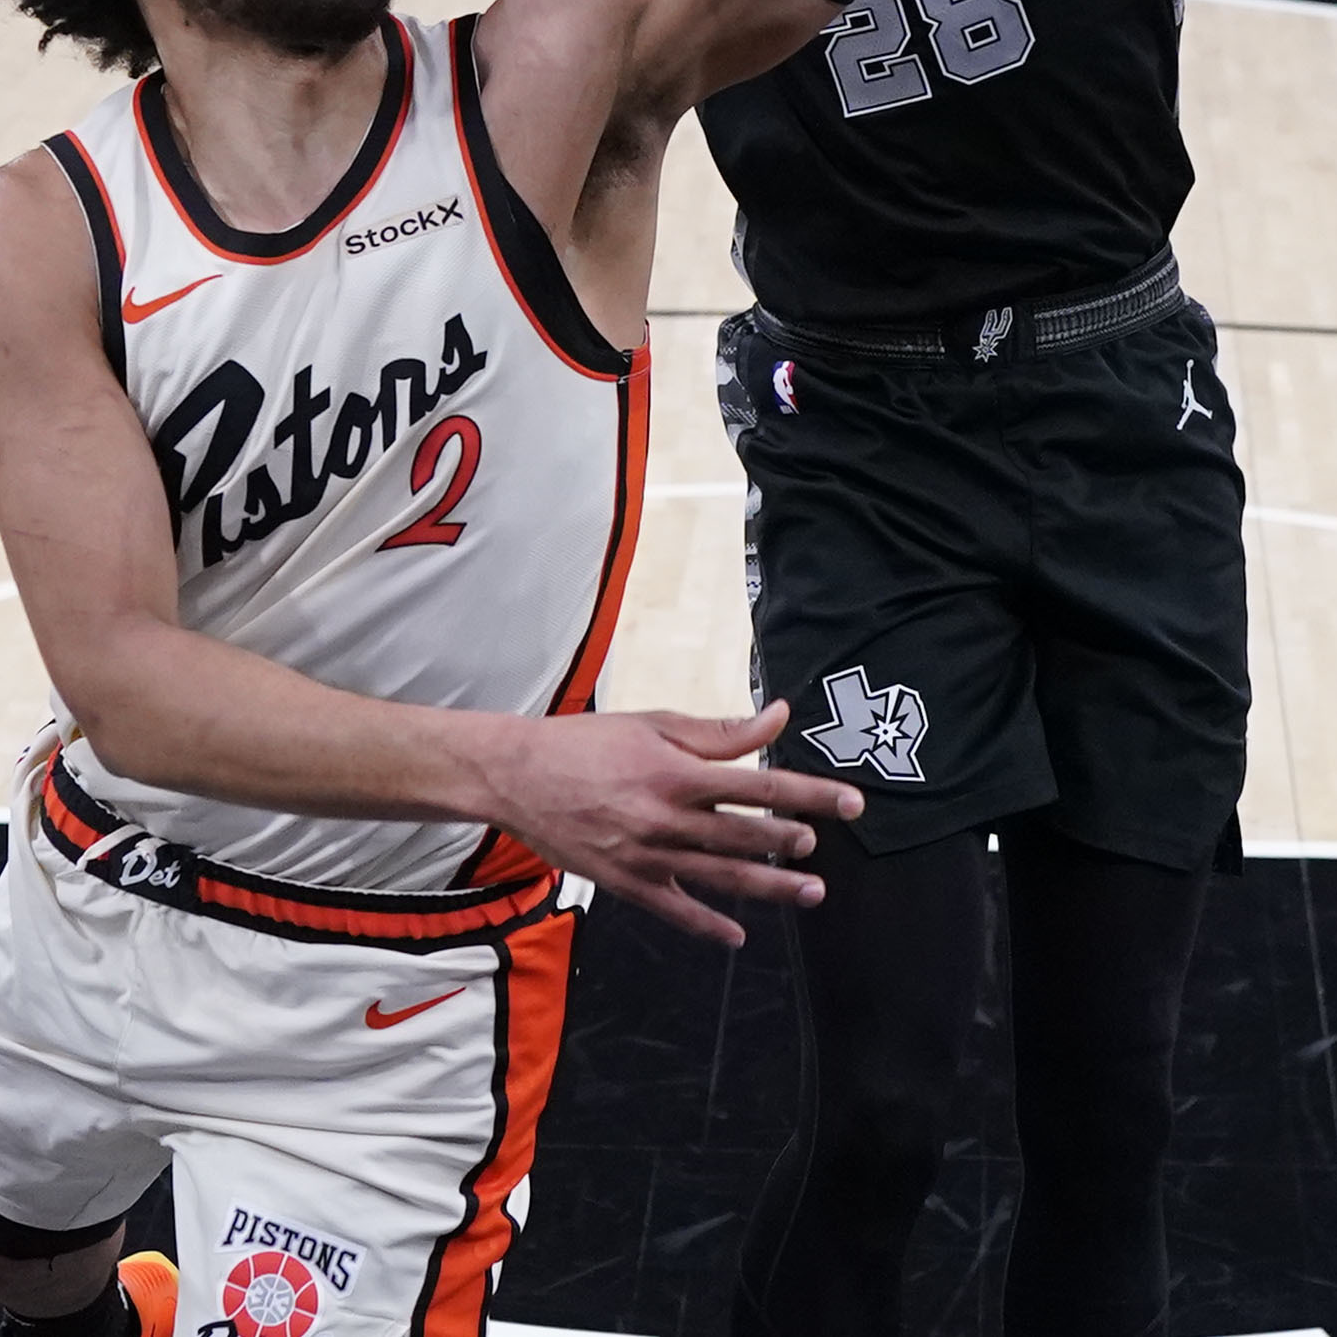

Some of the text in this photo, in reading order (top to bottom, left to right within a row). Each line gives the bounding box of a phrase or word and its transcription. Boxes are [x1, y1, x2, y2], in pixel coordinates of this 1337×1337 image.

[345, 198, 463, 254] StockX
[152, 313, 488, 569] Pistons
[374, 414, 482, 553] 2
[221, 1207, 357, 1292] PISTONS
